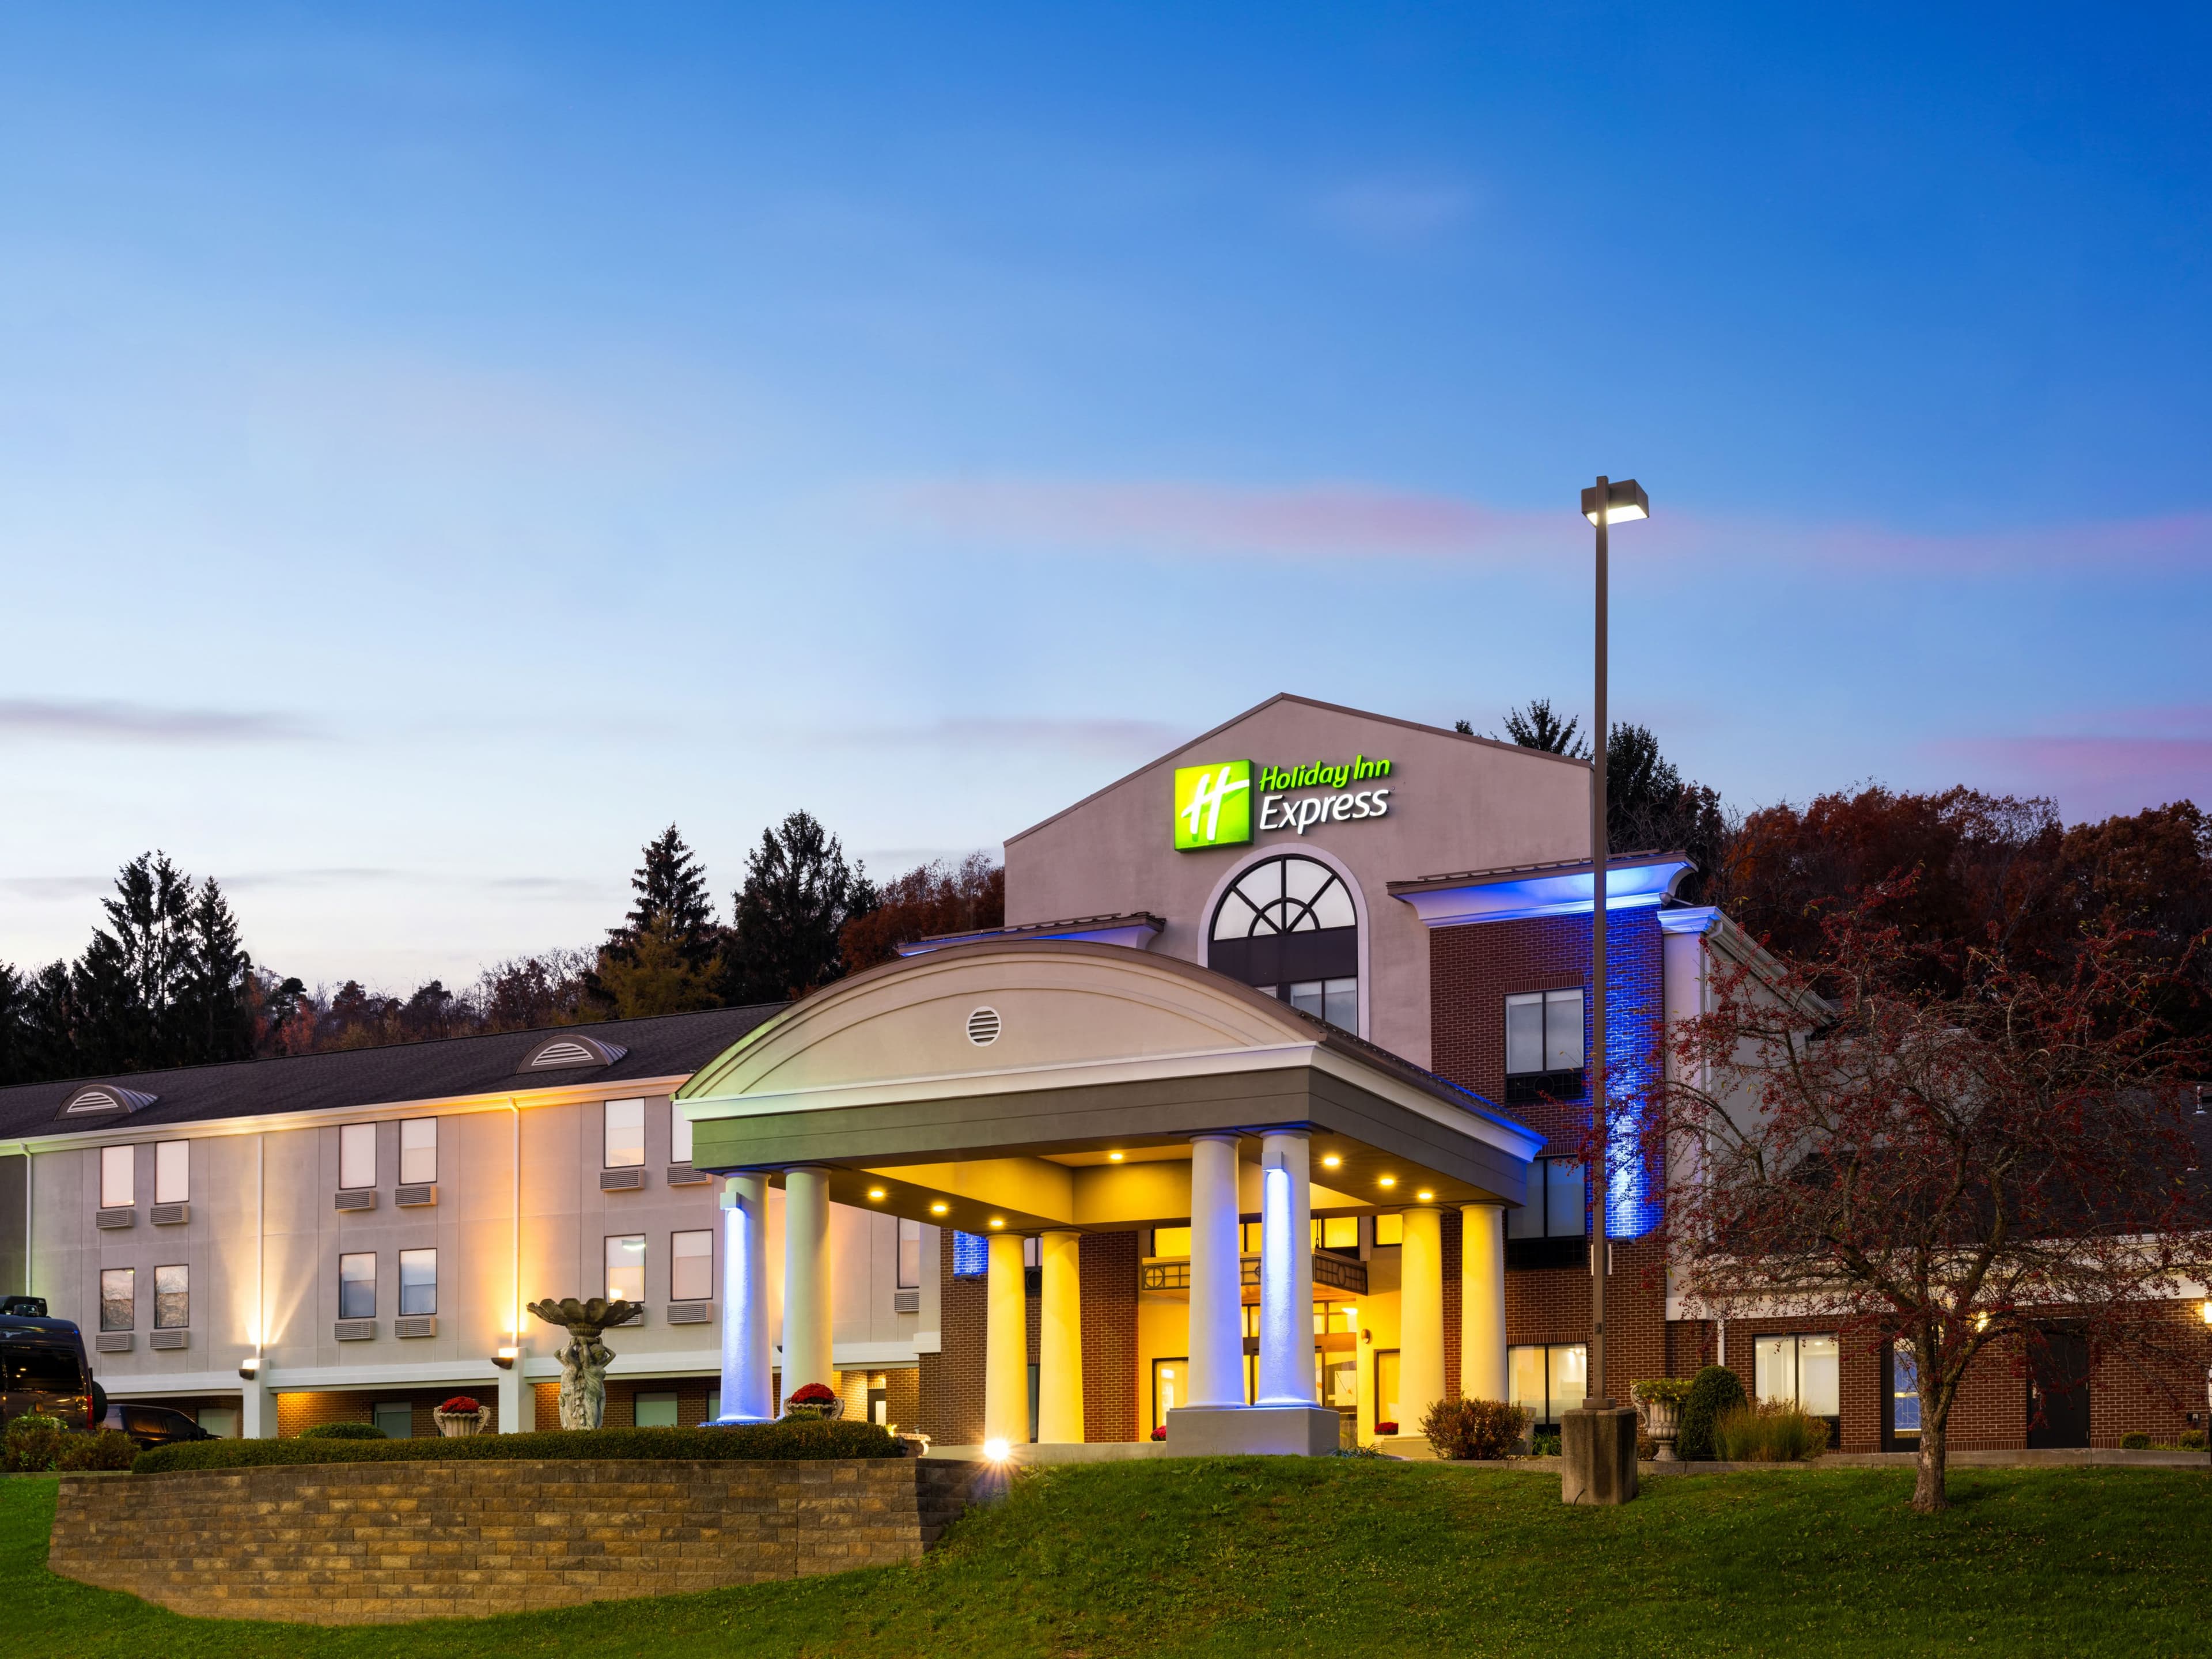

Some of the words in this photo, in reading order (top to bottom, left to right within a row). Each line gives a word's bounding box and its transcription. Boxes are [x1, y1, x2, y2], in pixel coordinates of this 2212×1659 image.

[1259, 760, 1351, 792] Holiday
[1354, 754, 1392, 780] Inn
[1181, 766, 1249, 840] H
[1259, 789, 1389, 835] Express
